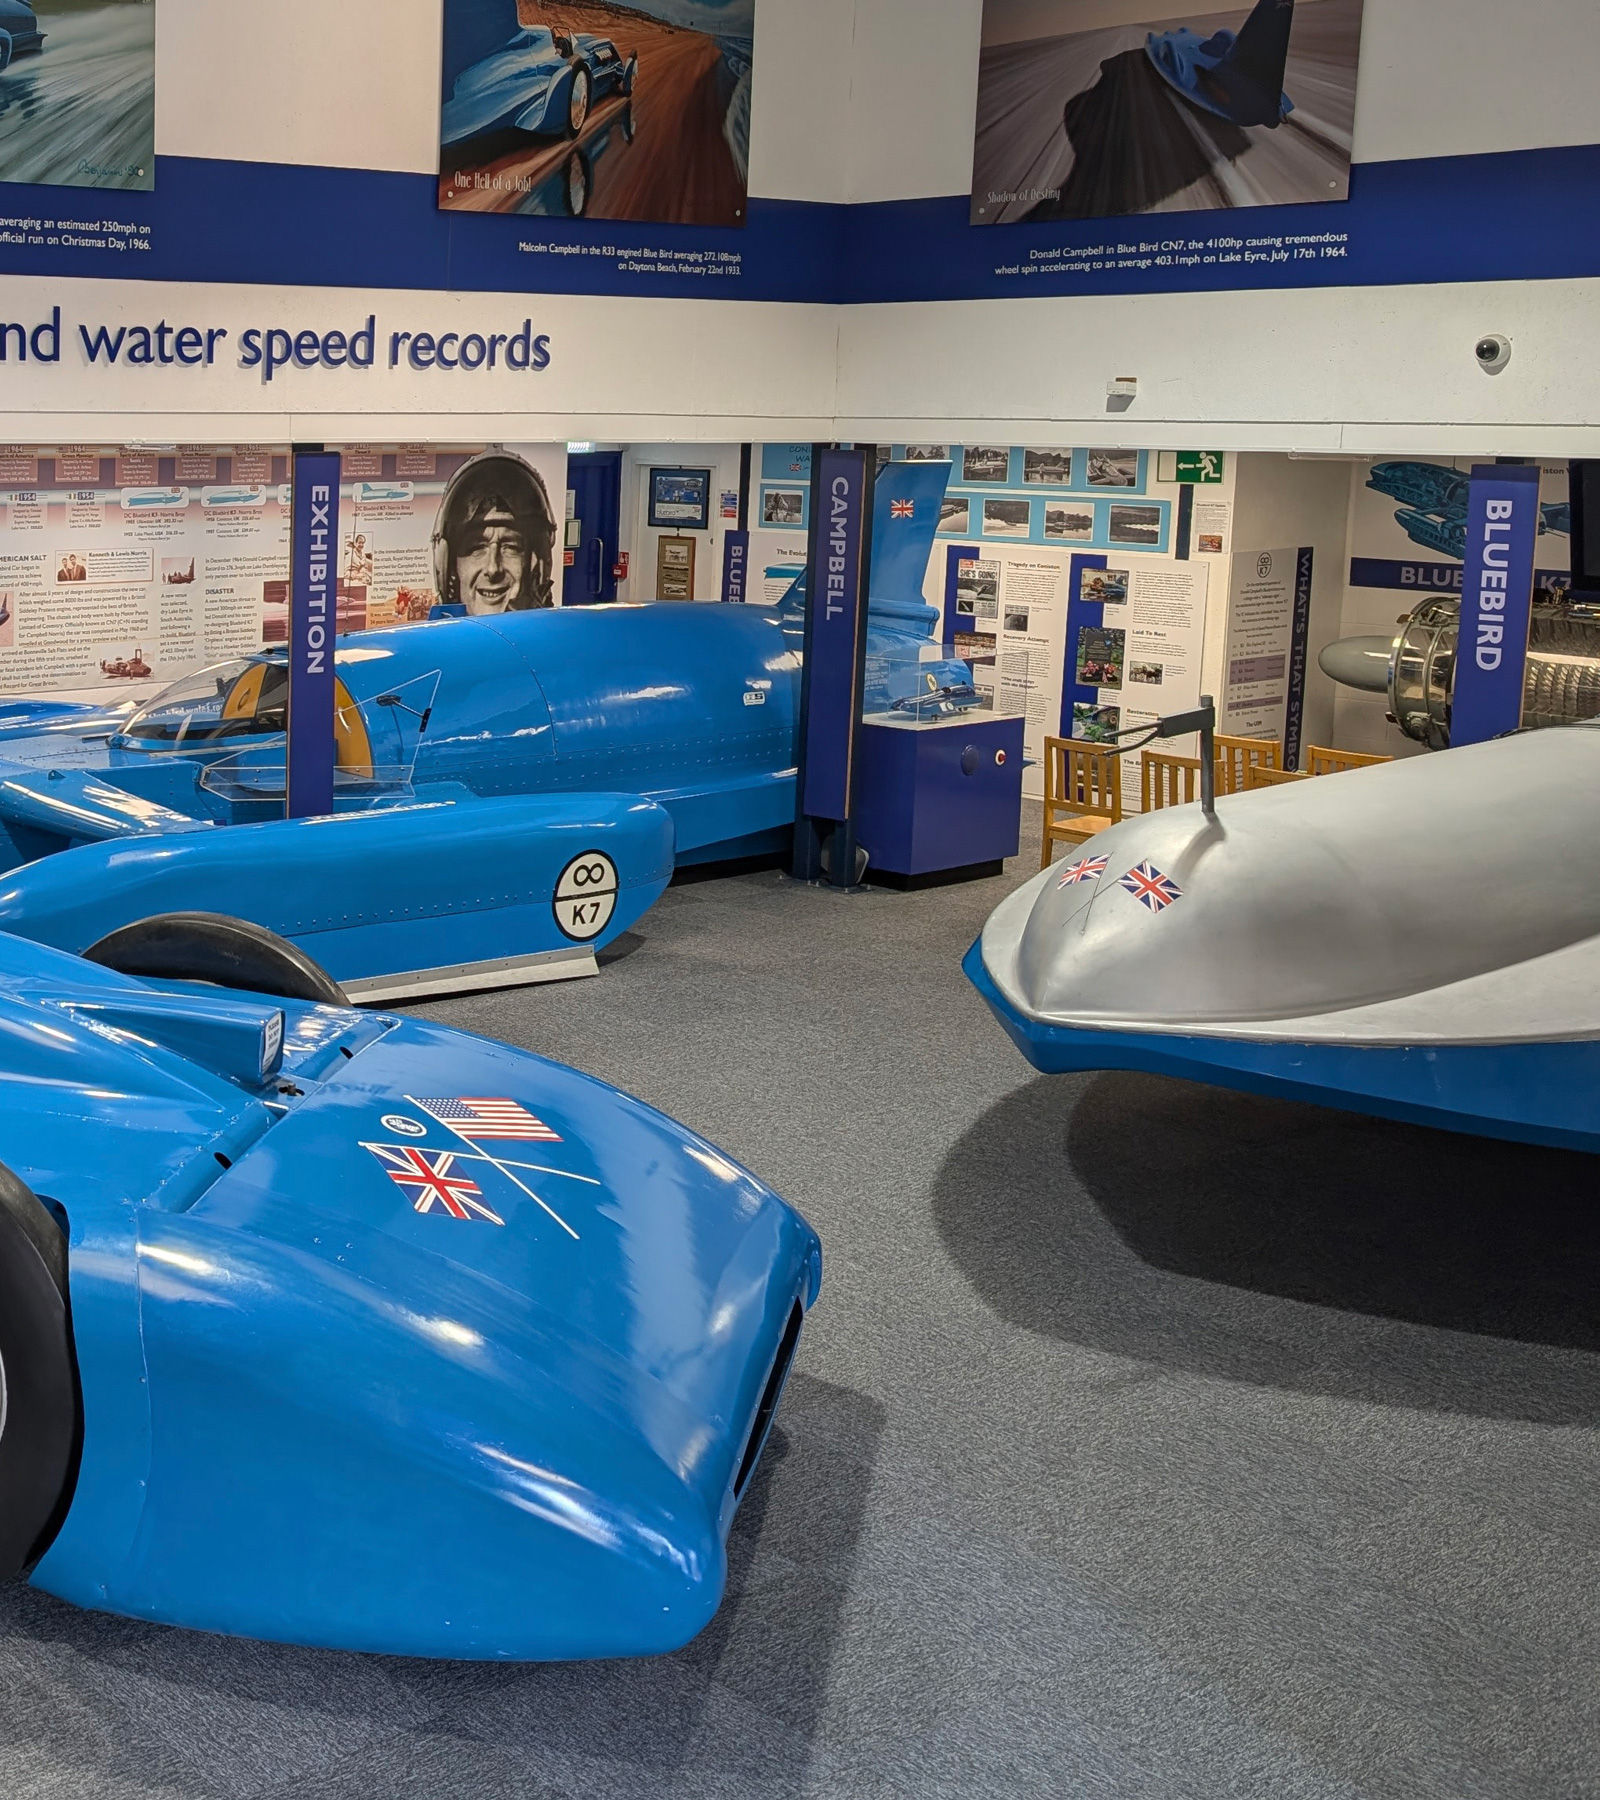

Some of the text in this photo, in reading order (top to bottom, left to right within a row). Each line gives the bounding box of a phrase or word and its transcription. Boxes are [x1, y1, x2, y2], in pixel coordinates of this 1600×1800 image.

[454, 171, 532, 192] One Hell of a Job!
[0, 217, 41, 231] averaging
[43, 220, 54, 228] an
[57, 219, 100, 231] estimated
[102, 220, 136, 236] 250mph
[139, 225, 150, 234] on
[28, 235, 44, 244] run
[46, 236, 59, 245] on
[61, 234, 106, 247] Christmas
[108, 237, 126, 251] Day,
[129, 238, 151, 250] 1966.
[518, 241, 742, 264] Malcolm Campbell in the R33 engined Blue Bird averaging 272.108mph
[1029, 232, 1348, 259] Donald Campbell in Blue Bird CN7, the 4100hp causing tremendous
[618, 260, 741, 276] on Daytona Beach, February 22nd 1933.
[994, 264, 1019, 274] wheel
[1021, 264, 1037, 275] spin
[1040, 261, 1090, 272] accelerating
[1092, 261, 1102, 269] to
[1117, 258, 1152, 269] average
[1154, 254, 1200, 266] 403.1mph
[1203, 255, 1216, 263] on
[1219, 251, 1241, 262] Lake
[1244, 251, 1270, 263] Eyre,
[1270, 250, 1289, 263] July
[1293, 247, 1315, 259] 17th
[1320, 246, 1348, 258] 1964.
[78, 318, 226, 364] water
[238, 316, 375, 382] speed
[389, 319, 551, 370] records
[1540, 467, 1564, 475] iston
[30, 554, 47, 562] SALT
[826, 476, 849, 620] CAMPBELL
[307, 485, 330, 674] EXHIBITION
[729, 546, 743, 603] BLUEB
[959, 568, 998, 580] SHE'S GOING!
[1259, 567, 1269, 575] K7
[1400, 567, 1464, 588] BLUE
[205, 587, 234, 595] DISASTER
[1475, 500, 1513, 671] BLUEBIRD
[1286, 553, 1311, 772] WHAT'S THAT SYMBO
[572, 902, 600, 926] K7
